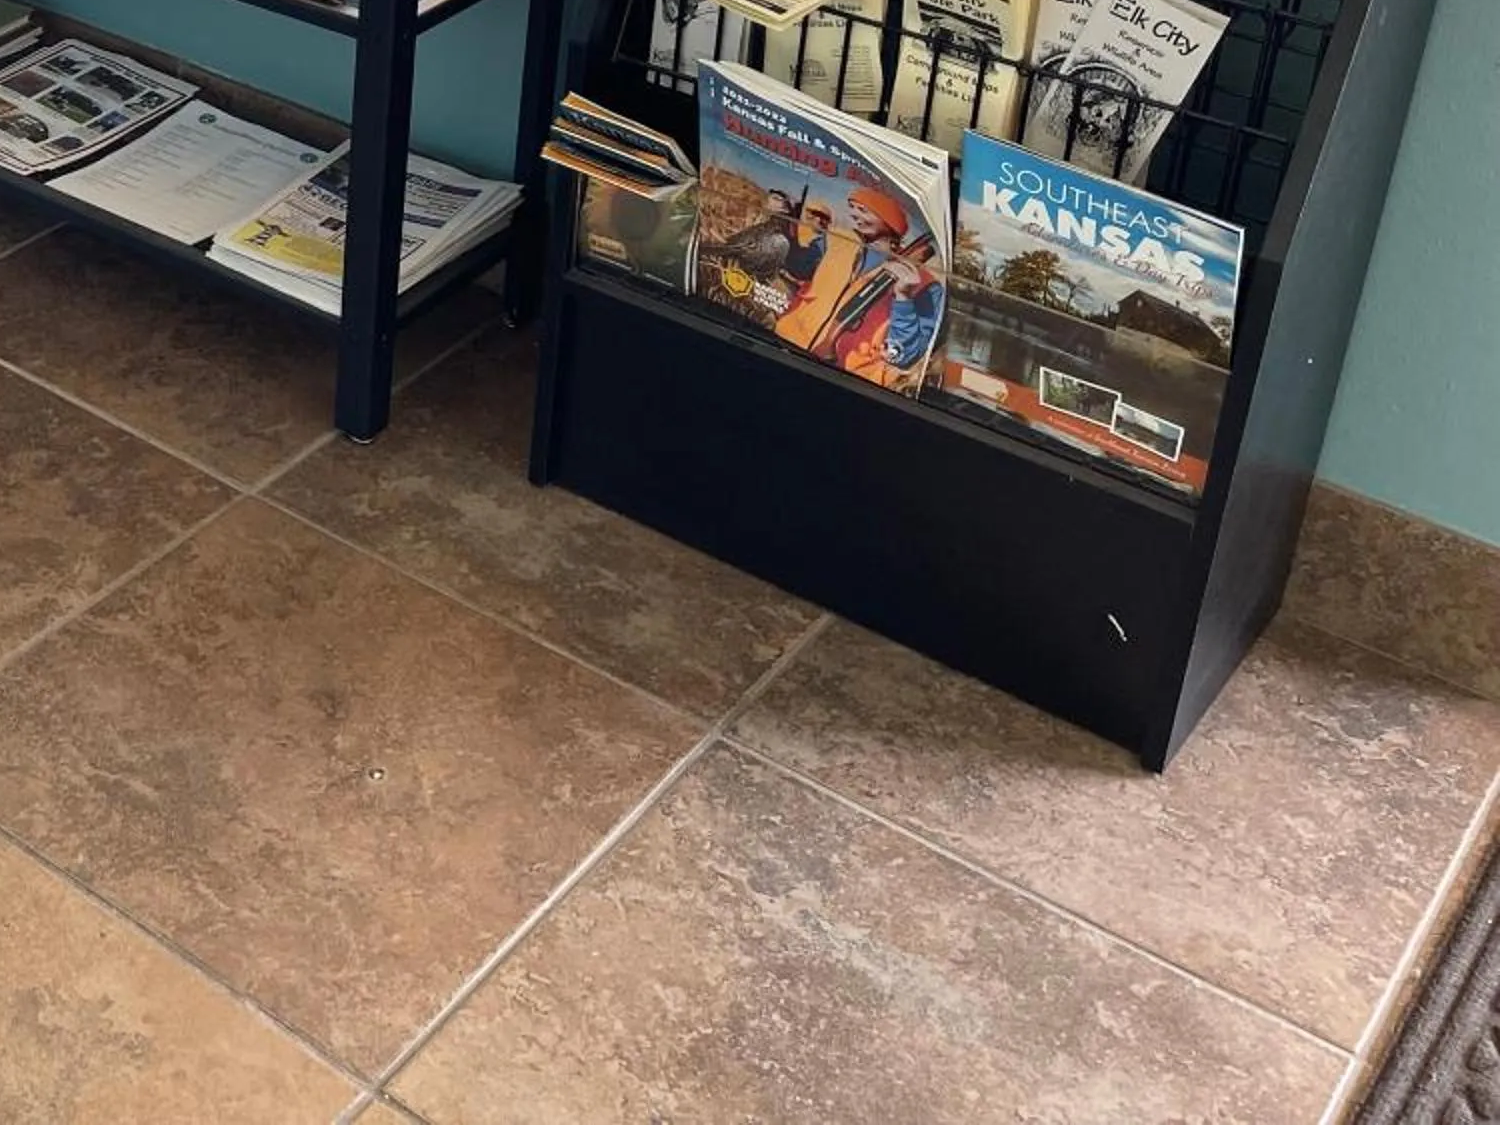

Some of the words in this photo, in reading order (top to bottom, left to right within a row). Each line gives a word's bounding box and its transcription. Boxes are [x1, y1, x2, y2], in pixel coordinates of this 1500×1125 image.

[960, 3, 1001, 25] Park
[1152, 19, 1201, 57] City
[721, 96, 777, 133] Kansas
[777, 124, 812, 146] Fall
[813, 136, 827, 151] &
[999, 160, 1185, 246] SOUTHEAST
[982, 179, 1206, 284] KANSAS
